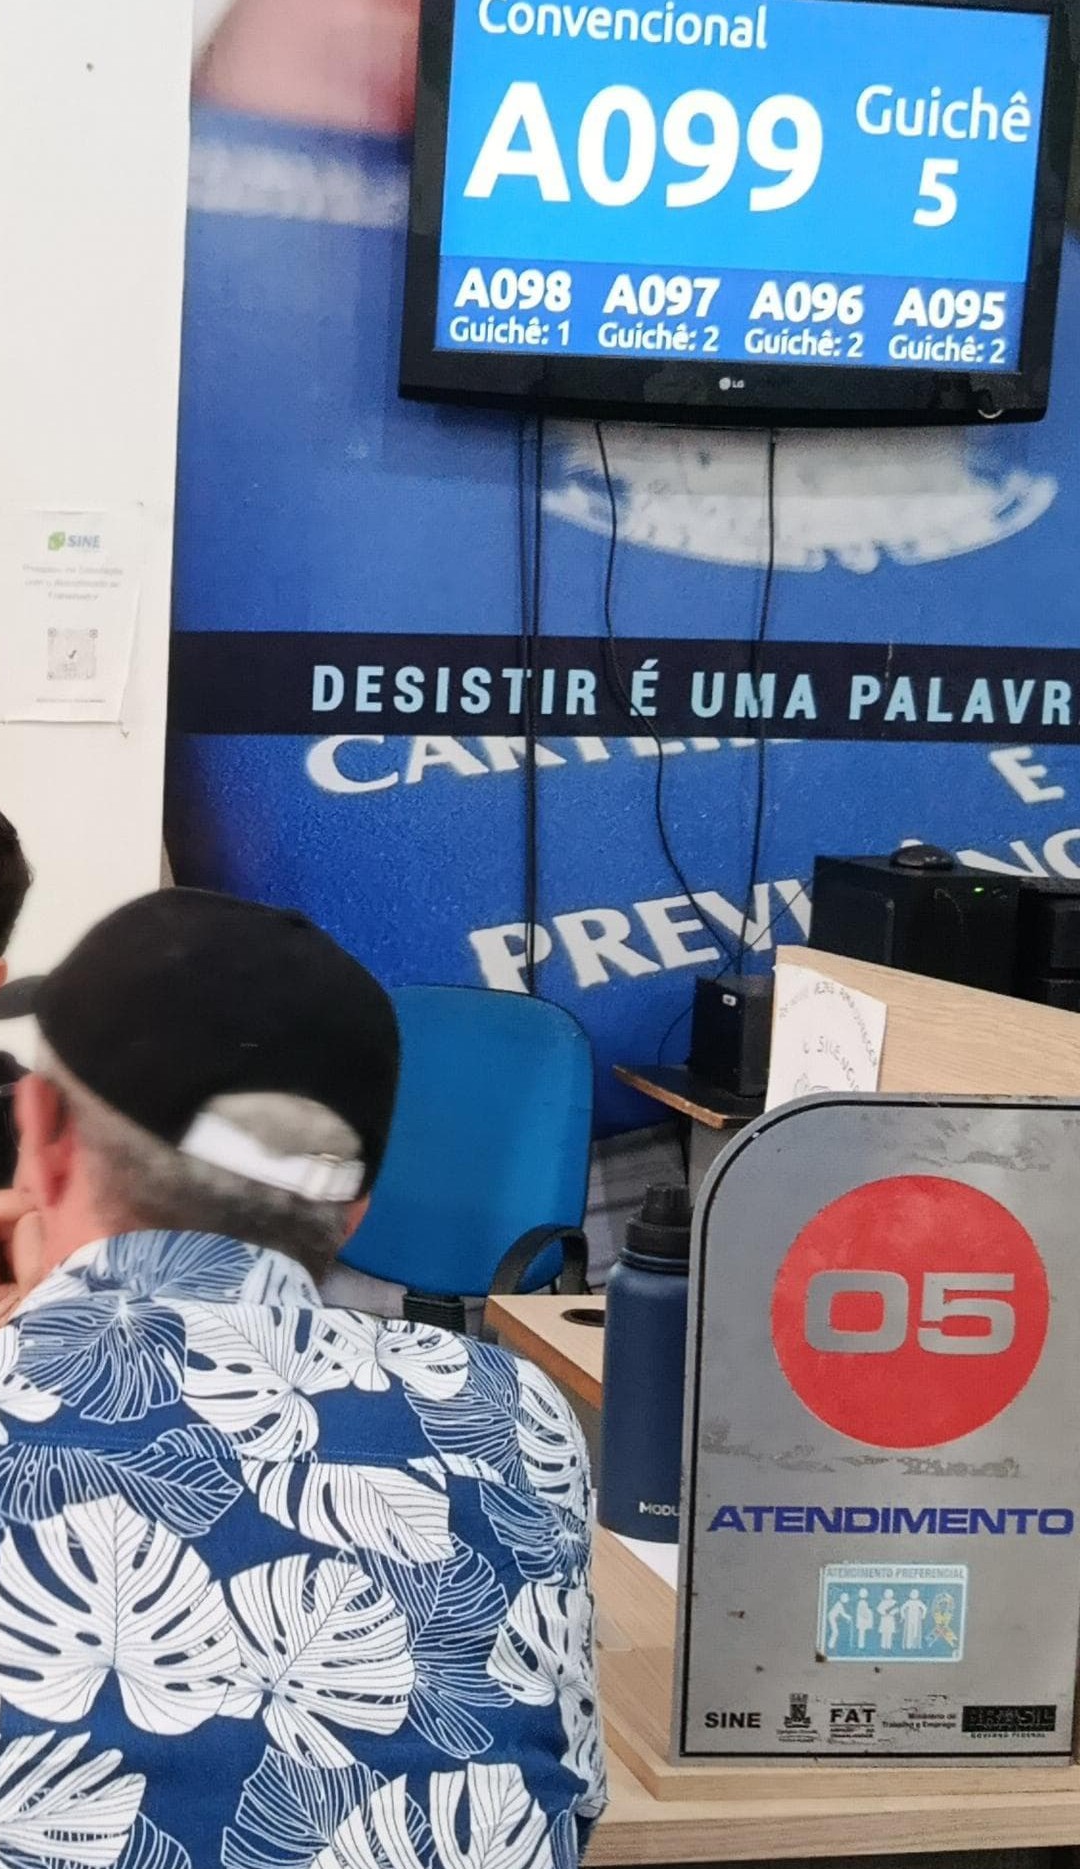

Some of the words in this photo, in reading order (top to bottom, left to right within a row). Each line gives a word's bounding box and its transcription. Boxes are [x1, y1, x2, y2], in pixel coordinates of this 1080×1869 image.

[479, 0, 768, 50] Convencional
[856, 84, 1033, 143] Guichê
[463, 81, 824, 212] A099
[912, 158, 960, 227] 5
[454, 268, 571, 312] A098
[603, 273, 721, 318] A097
[749, 280, 864, 325] A096
[893, 287, 1007, 332] A095
[449, 316, 549, 346] Guichê:
[558, 323, 571, 345] 1
[598, 321, 696, 352] Guichê:
[703, 328, 719, 352] 2
[745, 327, 841, 358] Guichê:
[848, 334, 864, 358] 2
[888, 333, 985, 363] Guichê:
[990, 340, 1006, 364] 2
[312, 665, 597, 716] DESISTIR
[629, 660, 660, 718] É
[690, 671, 819, 720] UMA
[848, 675, 1080, 726] PALAVR
[990, 747, 1065, 804] E
[804, 1269, 1016, 1356] 05
[707, 1505, 1074, 1535] ATENDIMENTO
[704, 1711, 762, 1729] SINE
[829, 1708, 876, 1723] FAT
